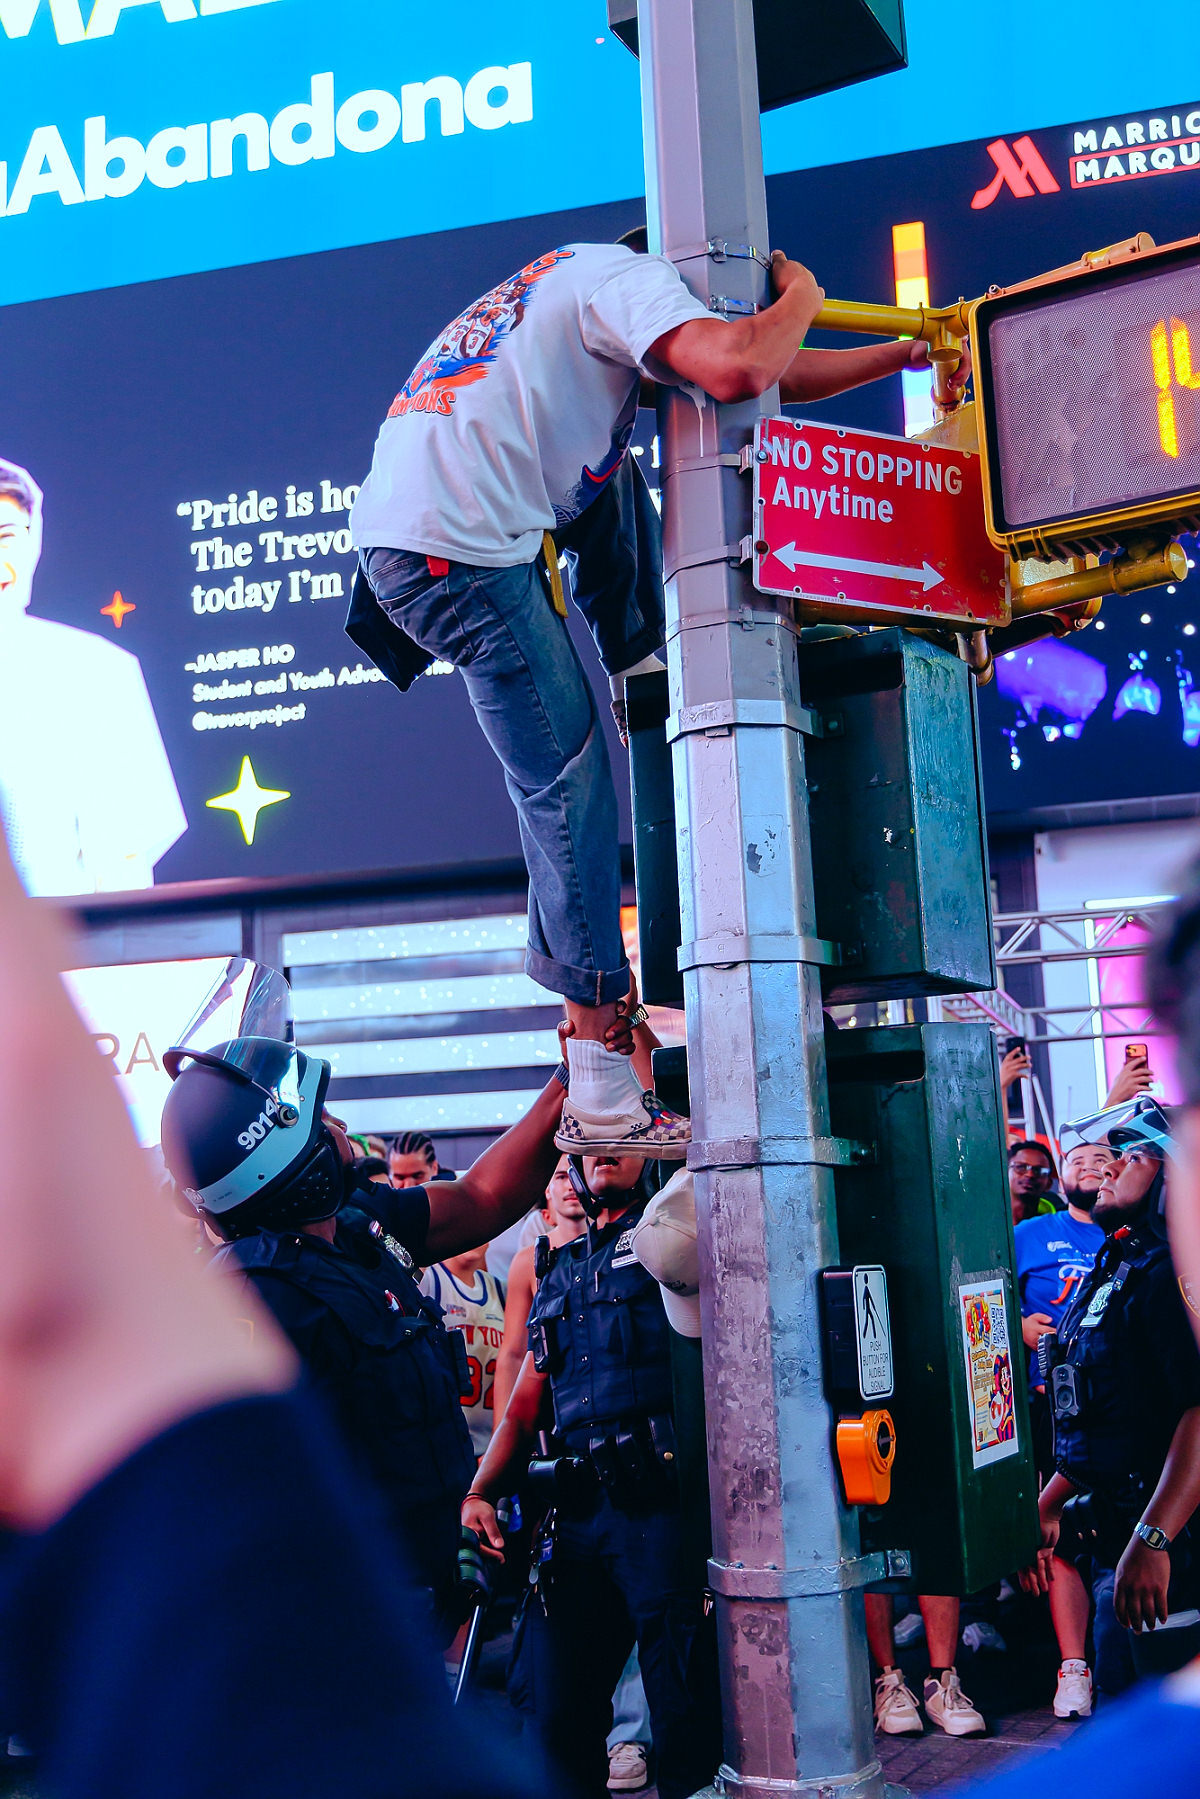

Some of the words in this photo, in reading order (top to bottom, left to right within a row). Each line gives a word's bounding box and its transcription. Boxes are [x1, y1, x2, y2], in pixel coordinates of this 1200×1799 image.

[772, 436, 812, 470] NO
[822, 445, 962, 495] STOPPING
[286, 486, 313, 517] is
[772, 477, 893, 523] Anytime
[191, 537, 252, 571] The
[259, 527, 359, 563] Trevo
[191, 576, 281, 614] today
[263, 644, 295, 665] HO
[193, 679, 252, 702] Student
[254, 673, 287, 695] and
[289, 668, 335, 690] Youth
[237, 1097, 279, 1150] 9014
